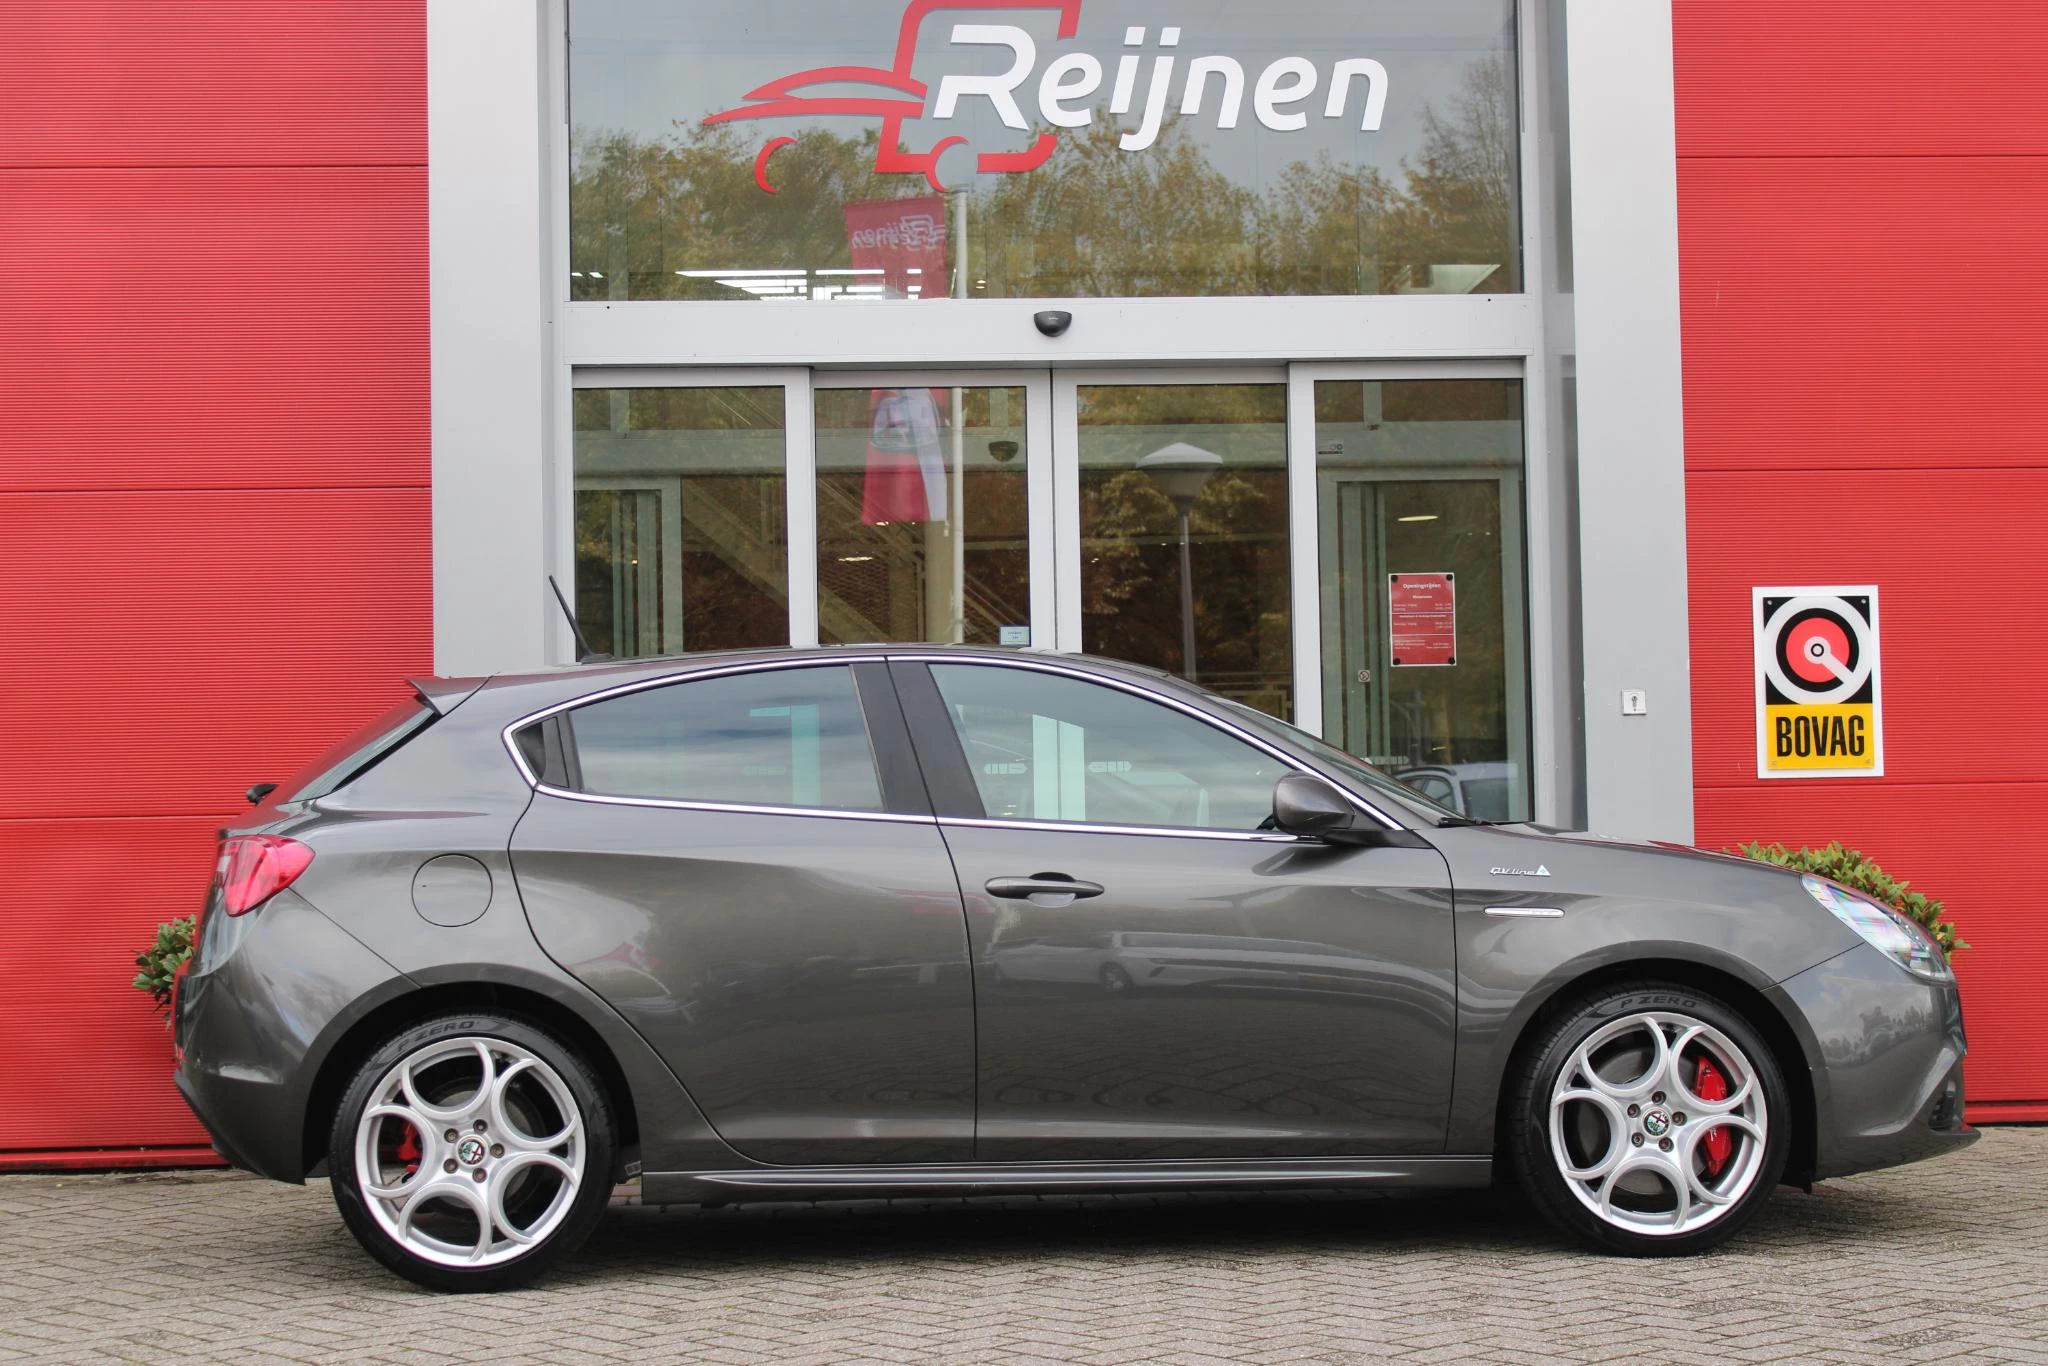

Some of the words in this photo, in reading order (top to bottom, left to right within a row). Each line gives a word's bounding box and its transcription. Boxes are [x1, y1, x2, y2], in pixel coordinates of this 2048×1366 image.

[933, 24, 1390, 151] Reijnen
[1775, 714, 1865, 757] BOVAG
[1637, 995, 1697, 1008] ZERO
[415, 1021, 475, 1042] ZERO
